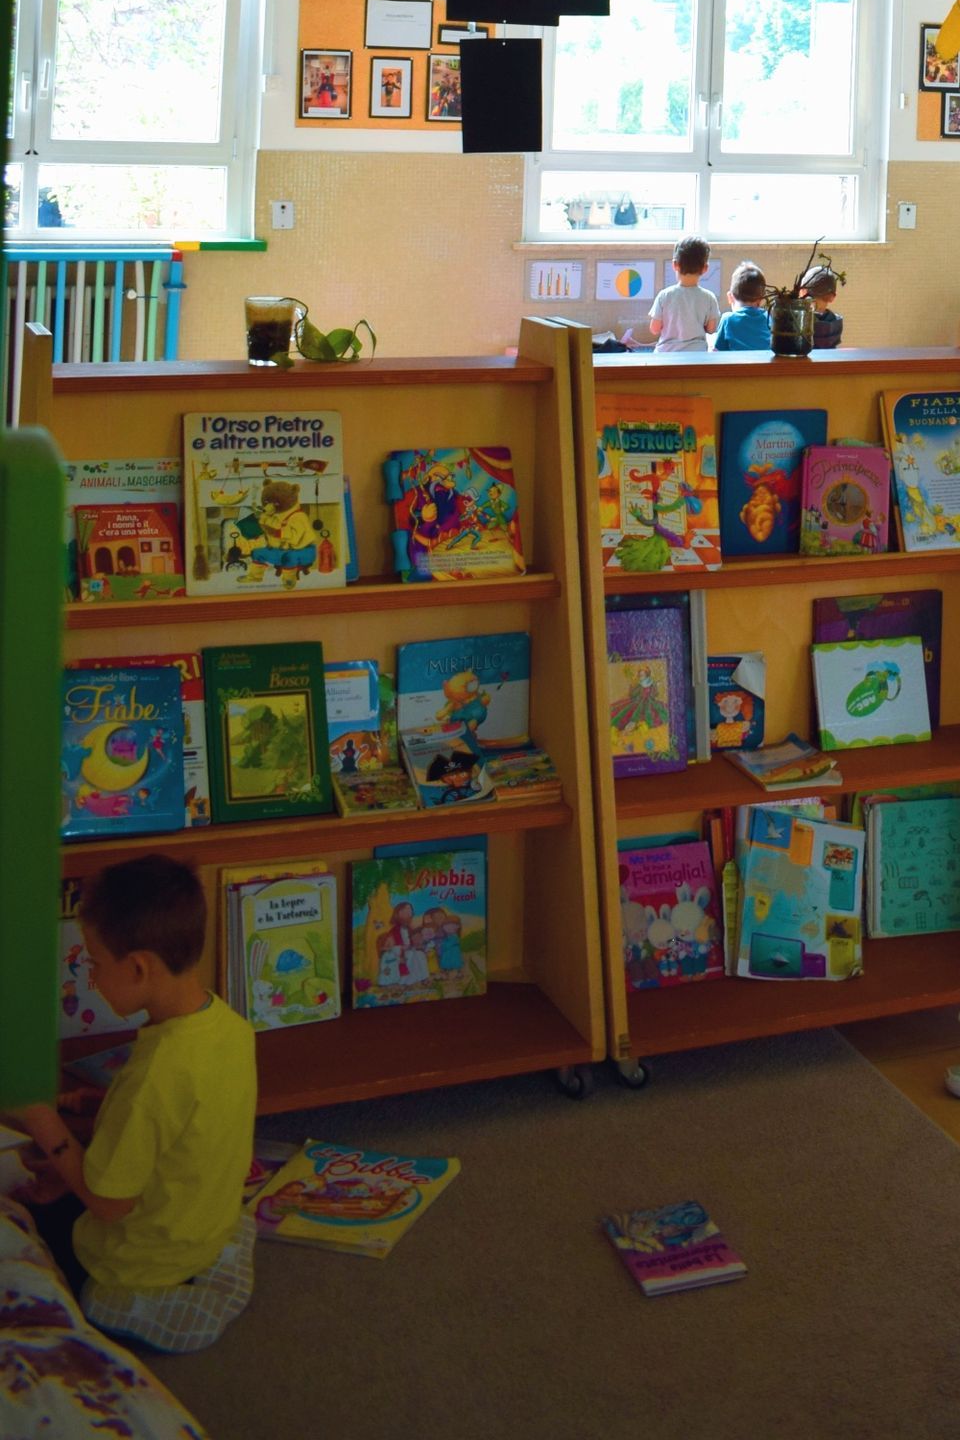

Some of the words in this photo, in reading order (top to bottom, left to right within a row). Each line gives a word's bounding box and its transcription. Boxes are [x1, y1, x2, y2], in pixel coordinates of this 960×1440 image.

[922, 407, 958, 416] DELLA
[201, 416, 261, 434] l'Orso
[264, 415, 324, 433] Pietro
[192, 437, 205, 449] e
[209, 433, 260, 450] altre
[262, 431, 334, 449] novelle
[755, 439, 795, 449] Martino
[125, 462, 136, 471] 56
[80, 476, 121, 489] ANIMALI
[116, 514, 140, 523] Anna,
[429, 653, 503, 673] MIRTILLO
[269, 672, 311, 689] Bosco
[65, 684, 160, 725] Fiabe
[408, 868, 475, 891] Bibbia
[632, 860, 706, 888] Famiglia!
[318, 1152, 432, 1185] Bibbia
[703, 1253, 724, 1262] La
